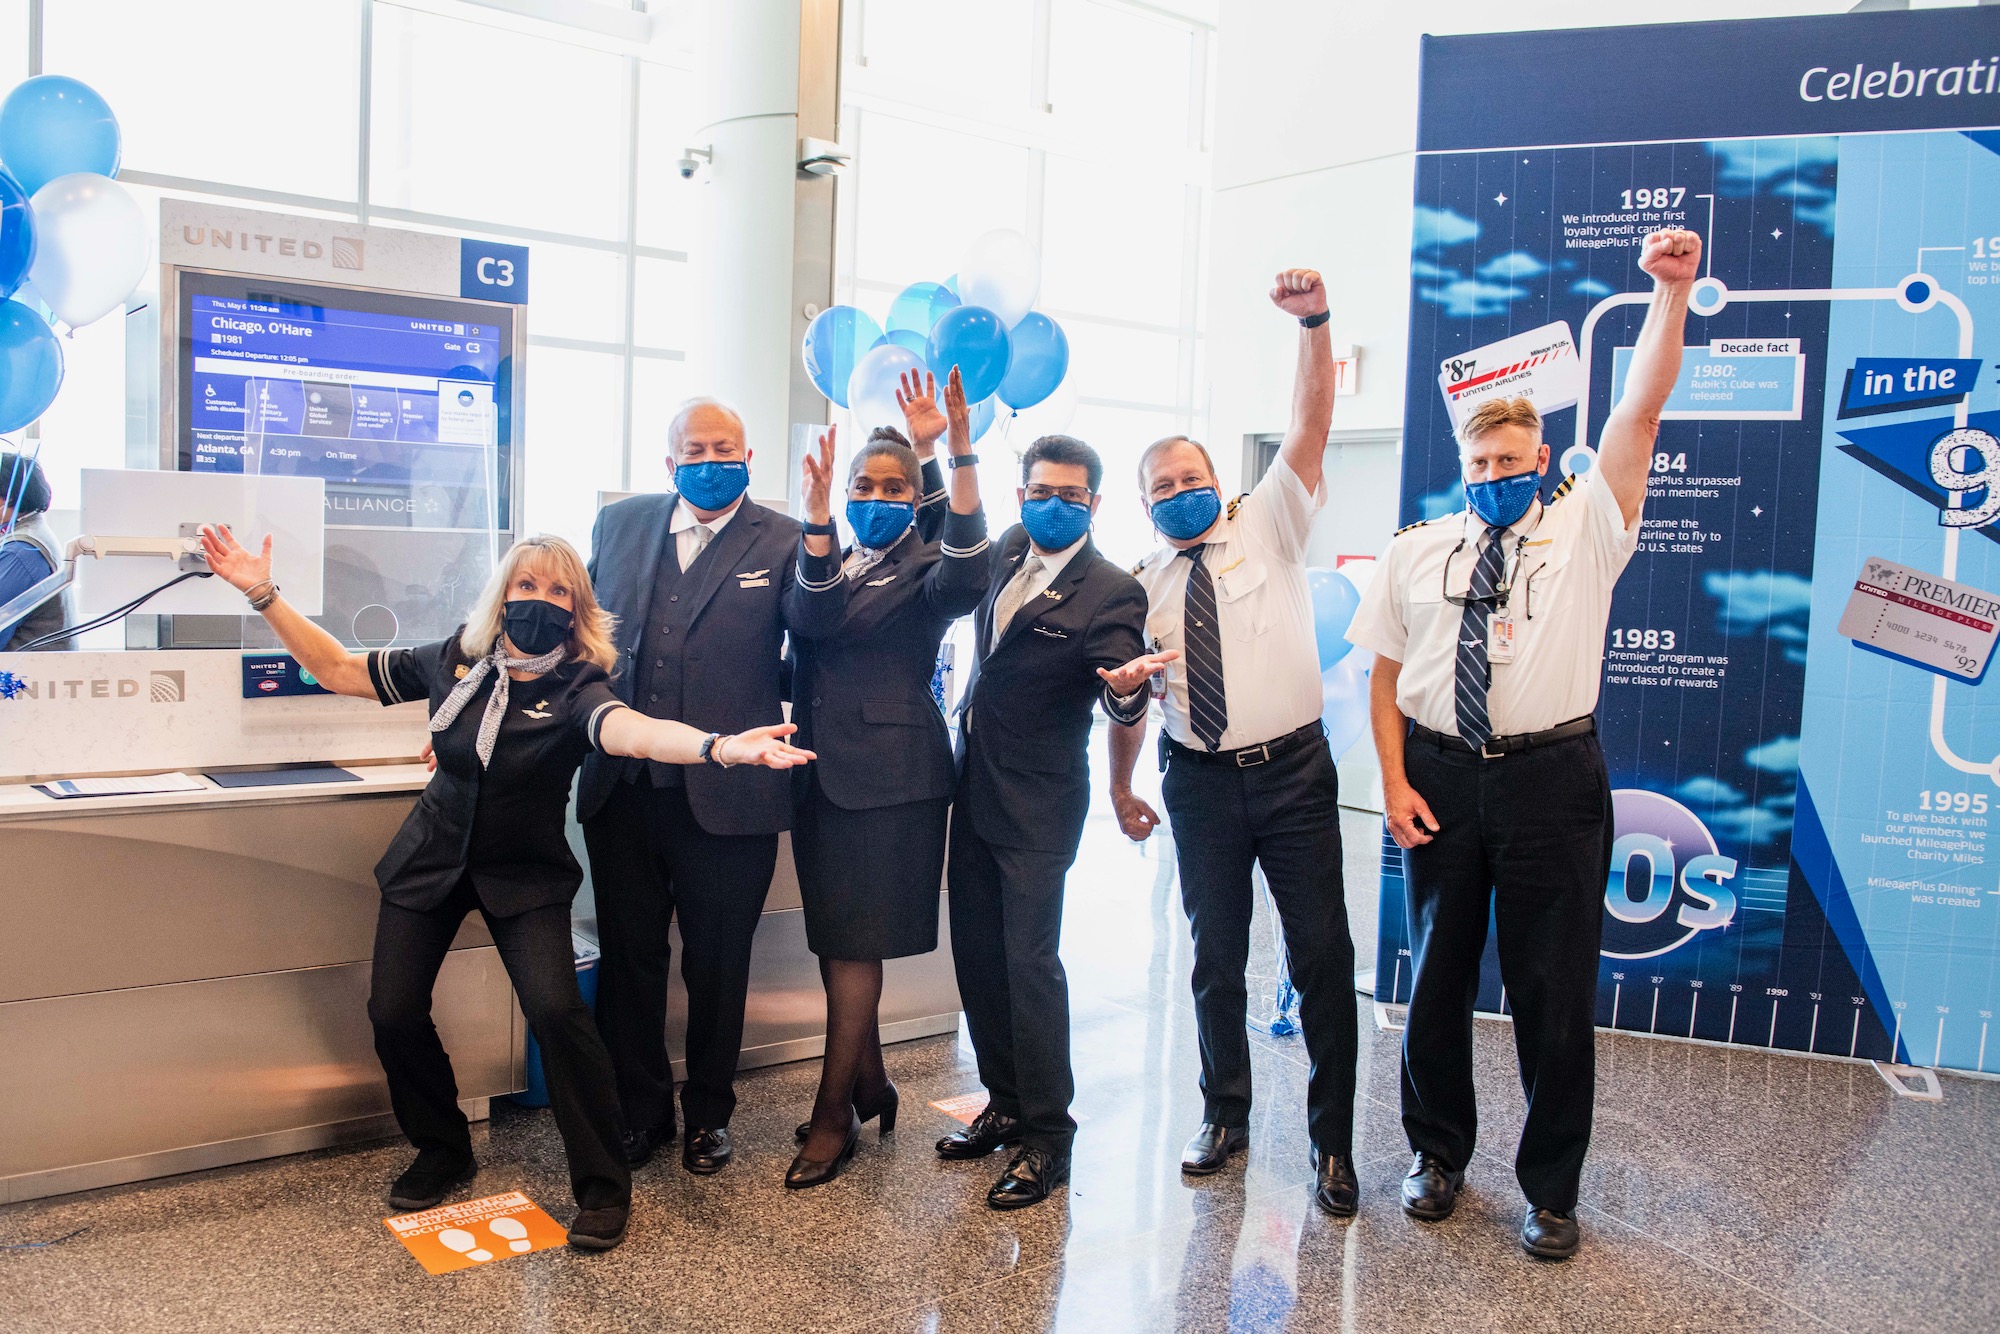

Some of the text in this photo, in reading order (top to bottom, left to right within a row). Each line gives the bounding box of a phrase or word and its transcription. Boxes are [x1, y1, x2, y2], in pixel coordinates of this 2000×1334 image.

[1800, 57, 2000, 102] Celebrati
[1621, 187, 1686, 209] 1987
[1562, 211, 1685, 223] We introduced the first
[1564, 226, 1601, 237] loyalty
[1603, 225, 1635, 235] credit
[184, 225, 323, 259] UNITED
[1565, 237, 1643, 249] MileagePlus Fi
[476, 257, 514, 287] C3
[1969, 262, 1987, 271] We
[1968, 274, 2000, 286] top ti
[212, 300, 226, 308] Thu,
[227, 302, 241, 310] May
[211, 317, 313, 337] Chicago, O'Hare
[411, 322, 452, 332] UNITED
[222, 335, 242, 344] 1981
[444, 342, 480, 353] Gate C3
[1530, 346, 1551, 357] Mileage
[1721, 343, 1789, 352] Decade fact
[211, 349, 244, 358] Scheduled
[245, 351, 279, 361] Departure:
[280, 355, 297, 363] 12:05
[283, 368, 333, 380] Pre-boarding
[1693, 365, 1737, 377] 1980:
[1462, 371, 1532, 398] UNITED AIRLINES
[1691, 380, 1727, 388] Rubik's
[1730, 380, 1755, 388] Cube
[1863, 365, 1957, 396] in the
[1690, 392, 1733, 400] released
[196, 444, 254, 455] Atlanta, GA
[270, 448, 286, 456] 4:30
[326, 451, 337, 459] On
[1647, 476, 1741, 486] gePlus surpassed
[1646, 488, 1719, 497] lion members
[323, 497, 416, 512] ALLIANCE
[1681, 519, 1699, 528] the
[1641, 531, 1721, 542] airline to fly to
[1648, 543, 1668, 552] U.S.
[1671, 544, 1703, 553] states
[1859, 583, 1888, 597] UNITED
[1897, 596, 1951, 618] MILEAGE
[1902, 575, 2000, 620] PREMIER
[1612, 628, 1675, 650] 1983
[1886, 621, 1967, 654] 4000 1234 5678
[1659, 654, 1704, 664] program
[1707, 656, 1728, 664] was
[1608, 662, 1664, 673] introduced
[1667, 665, 1679, 674] to
[1682, 667, 1715, 676] create
[1607, 675, 1718, 688] new class of rewards
[16, 679, 140, 700] NITED
[1920, 790, 1988, 814] 1995
[1887, 811, 1987, 827] To give back with
[1886, 824, 1905, 833] our
[1909, 825, 1965, 838] members,
[1861, 833, 1985, 851] launched MileagePlus
[1907, 849, 1984, 864] Charity Miles
[1604, 832, 1738, 930] 0s
[1868, 877, 1935, 891] MileagePlus
[1912, 895, 1980, 907] was created
[1398, 948, 1412, 956] 198
[1612, 972, 1624, 980] '86
[1651, 976, 1664, 984] '87
[1690, 980, 1703, 988] '88
[1729, 984, 1742, 992] '89
[1765, 987, 1788, 997] 1990
[1810, 992, 1822, 1000] '91
[1851, 997, 1865, 1005] '92
[393, 1193, 518, 1225] THANK YOU FOR
[417, 1203, 508, 1226] PRACTICING
[400, 1204, 536, 1238] SOCIAL DISTANCING
